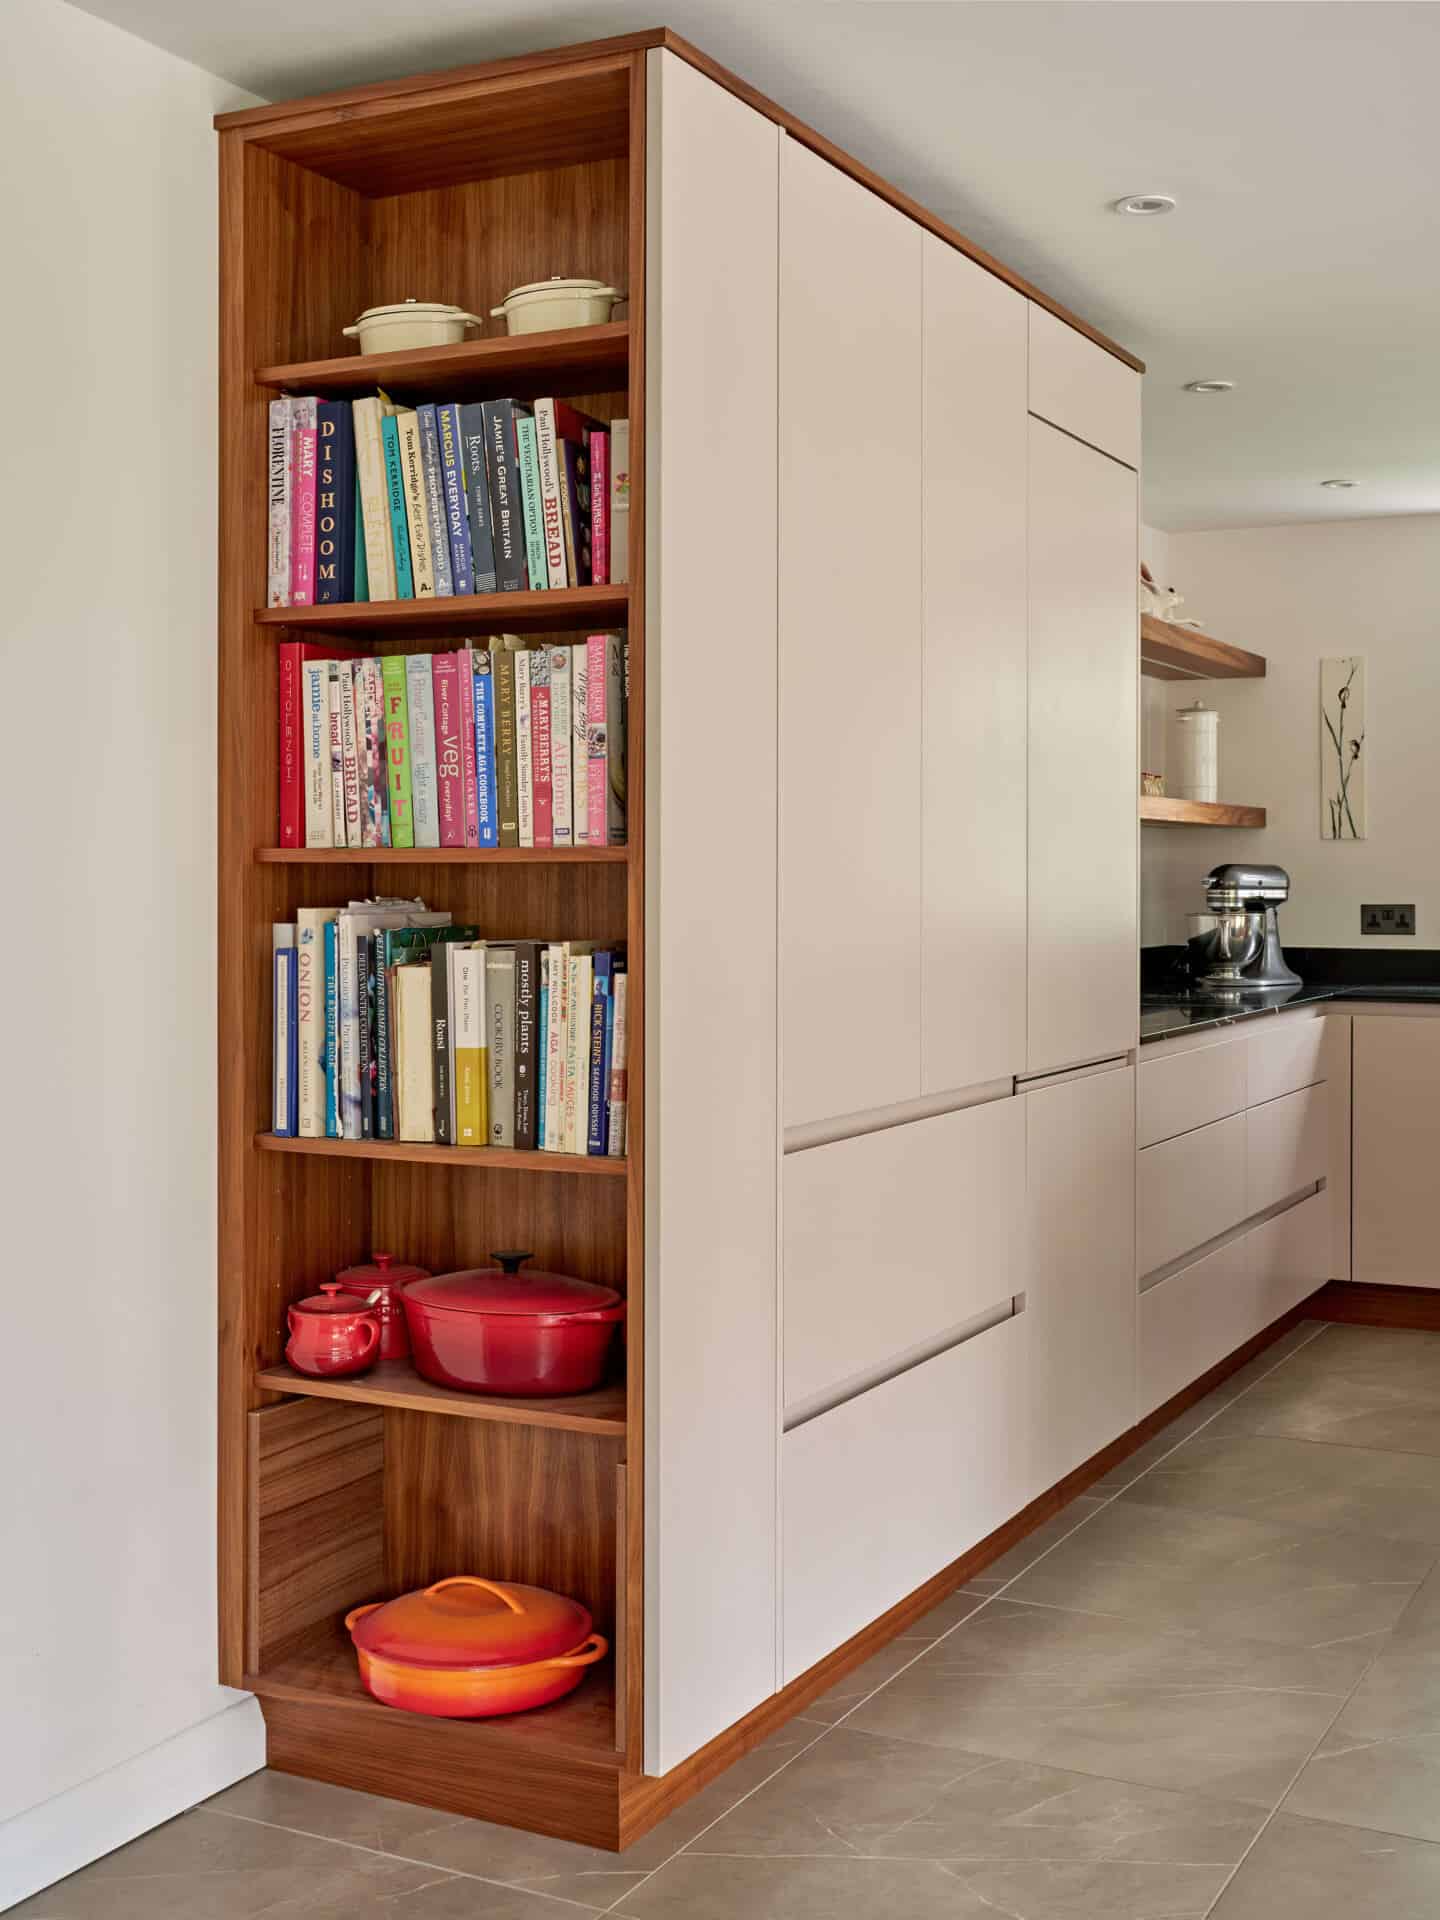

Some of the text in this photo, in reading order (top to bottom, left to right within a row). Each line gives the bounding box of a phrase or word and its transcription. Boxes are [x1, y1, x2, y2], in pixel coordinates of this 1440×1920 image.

[271, 427, 285, 506] FLORENTINE
[303, 436, 314, 477] MARY
[406, 428, 415, 450] Tom
[318, 420, 336, 581] DISHOOM
[386, 434, 401, 512] TOM KERRIDGE
[440, 409, 462, 537] MARCUS EVERYDAY
[493, 416, 512, 560] JAMIE'S GREAT BRITAIN
[521, 424, 538, 536] THE VEGETARIAN OPTION
[538, 410, 562, 568] Paul Hollywood's BREAD
[301, 492, 313, 553] COMPLETE
[428, 467, 440, 512] PROPER
[435, 537, 445, 570] FOOD
[459, 544, 467, 571] MARCUS
[308, 668, 324, 714] jamie
[413, 678, 426, 709] River
[500, 663, 512, 754] MARY BERRY
[592, 645, 605, 720] MARY BERRY
[283, 659, 293, 785] OTTOLENGHI
[312, 724, 324, 759] home
[329, 711, 340, 746] bread
[342, 672, 359, 824] Paul Hollywood's BREAD
[518, 658, 529, 828] Mary Berry's Family Sunday Lunches
[539, 699, 550, 782] MARY BERRY'S
[387, 695, 408, 817] FRUIT
[415, 762, 431, 787] light
[439, 679, 460, 822] River Cottage veg everyday!
[465, 753, 473, 775] AGA
[476, 681, 489, 823] THE COMPLETE AGA COOKBOOK
[555, 742, 569, 760] At
[416, 797, 427, 825] easy
[467, 778, 475, 815] CAKES
[555, 764, 570, 816] Home
[375, 934, 385, 960] DELIA
[552, 959, 560, 976] AMY
[299, 952, 312, 1023] ONION
[359, 980, 368, 1017] WINTER
[518, 960, 533, 1054] mostly plants
[551, 980, 559, 1024] WILLCOCK
[328, 975, 337, 1067] THE RECIPE BOOK
[377, 996, 386, 1037] SUMMER
[435, 1019, 447, 1050] Roast
[550, 1032, 560, 1055] AGA
[360, 1017, 369, 1073] COLLECTION
[377, 1037, 387, 1091] COLLECTION
[494, 1003, 504, 1089] COOKERY BOOK
[567, 1046, 576, 1077] PASTA
[591, 1003, 604, 1137] RICK STEIN'S SEAFOOD ODYSSEY
[566, 1079, 576, 1117] SAUCES
